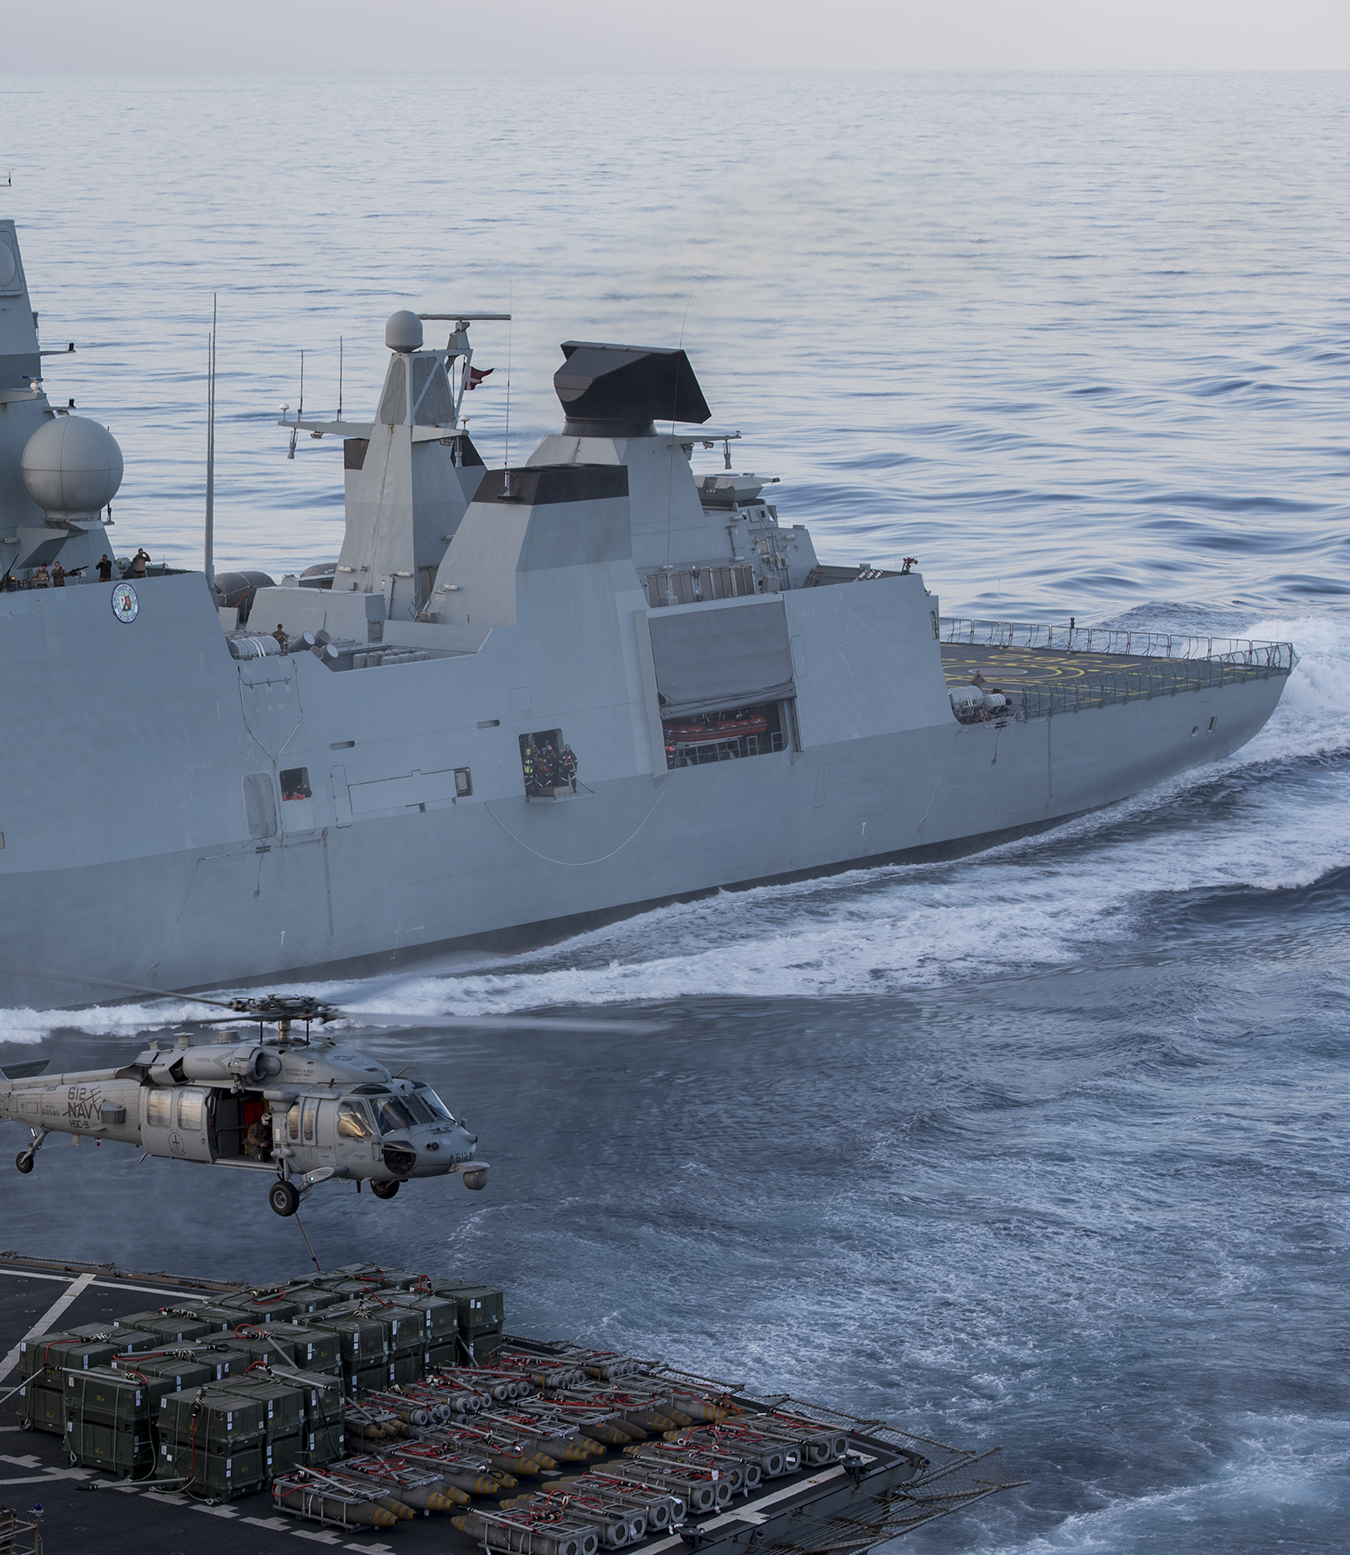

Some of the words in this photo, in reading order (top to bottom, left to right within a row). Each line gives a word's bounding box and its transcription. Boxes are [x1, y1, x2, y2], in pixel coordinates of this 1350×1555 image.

[68, 1087, 87, 1101] 612
[68, 1102, 102, 1120] NAVY
[69, 1119, 89, 1129] HSC-9
